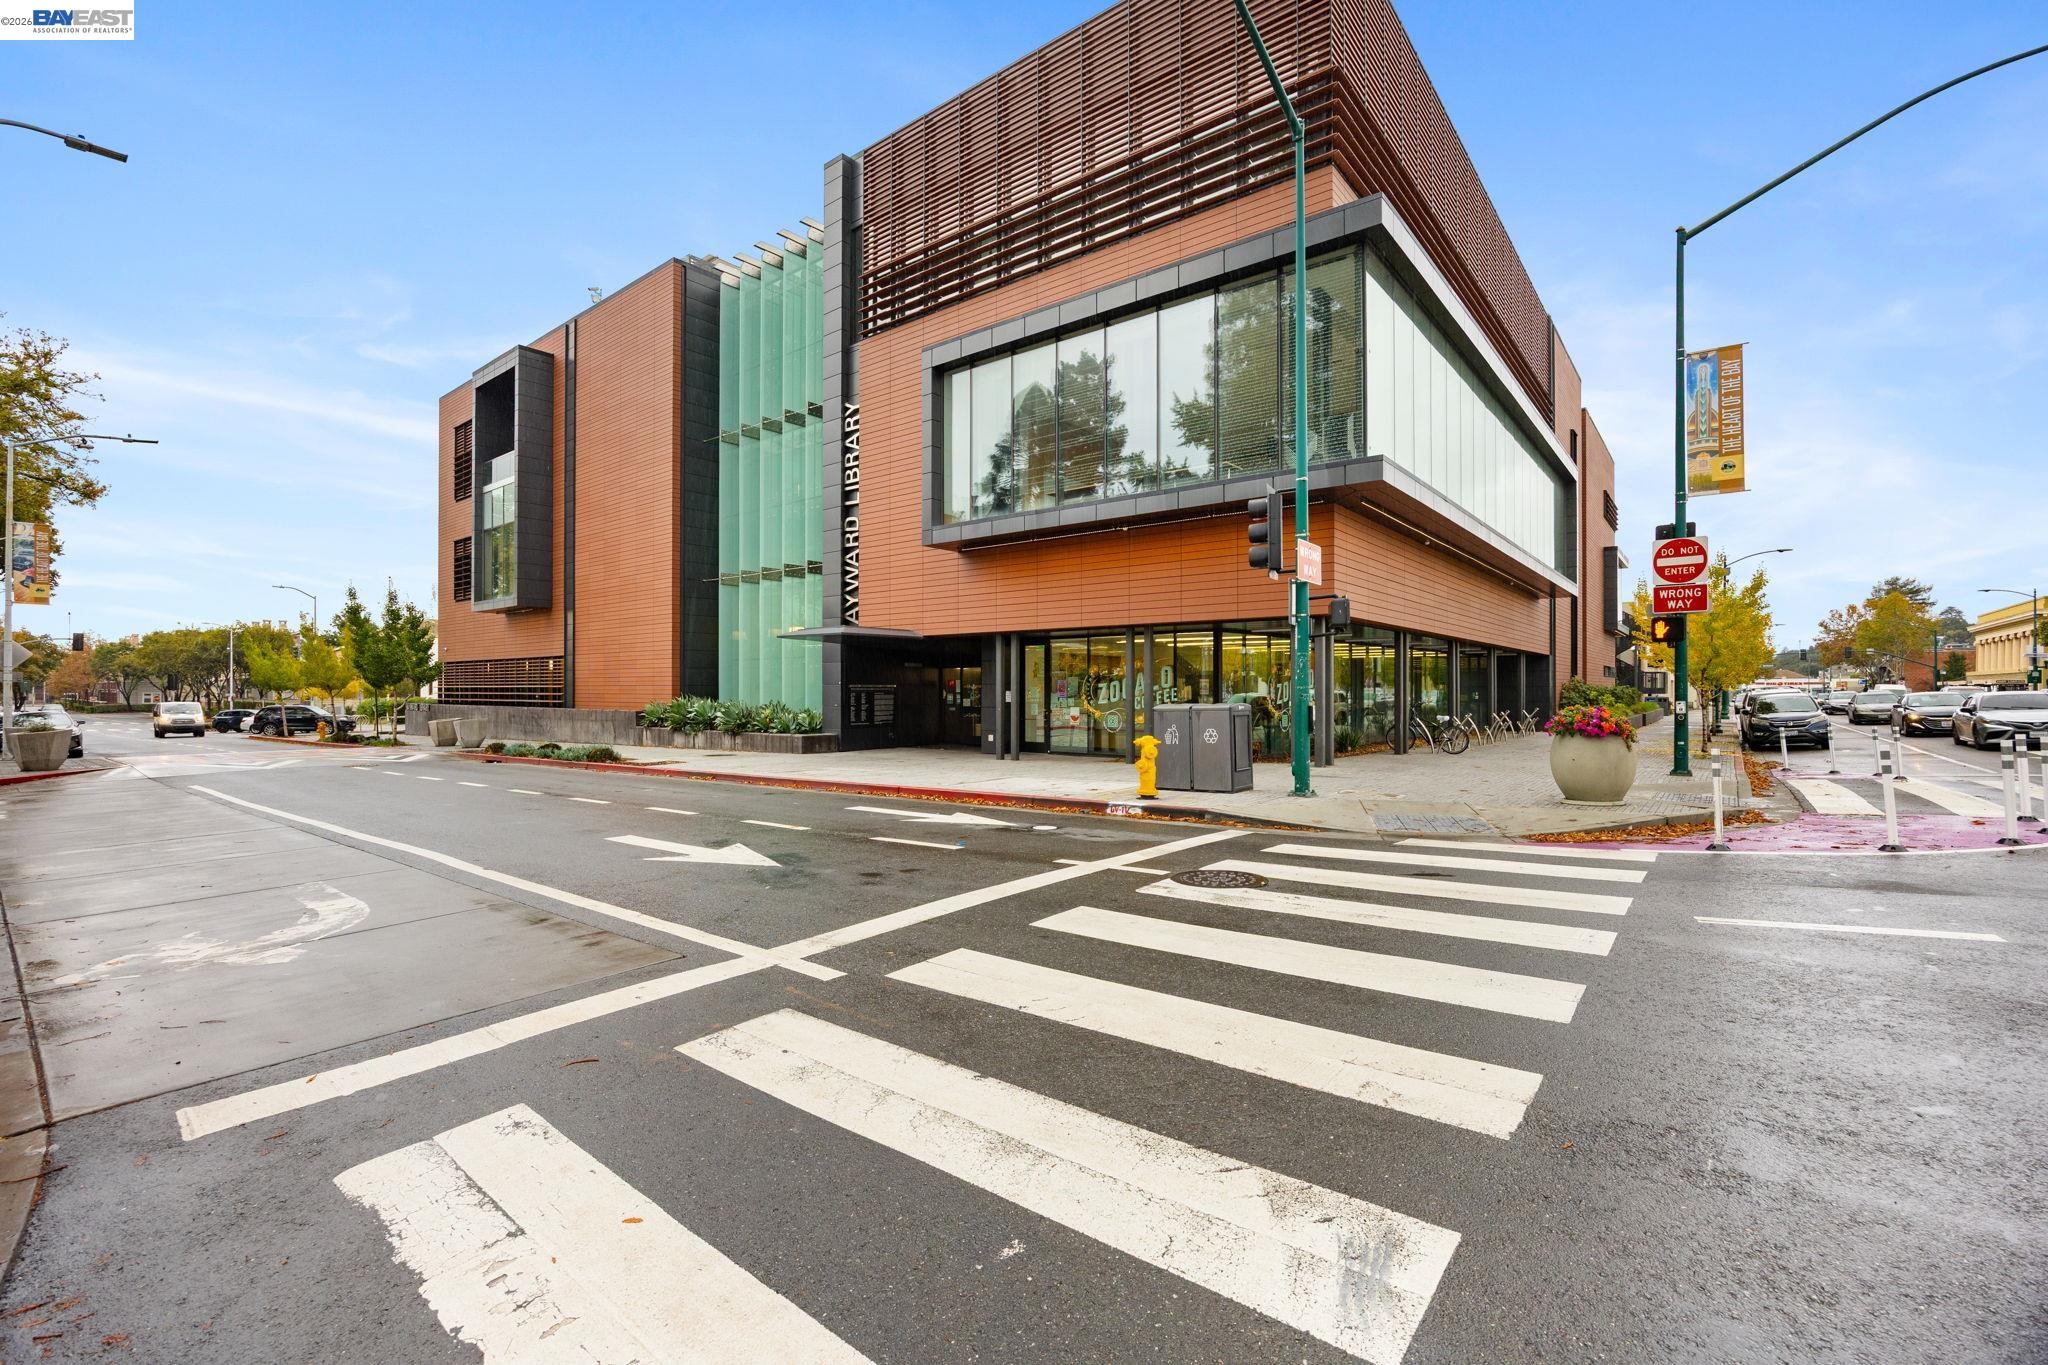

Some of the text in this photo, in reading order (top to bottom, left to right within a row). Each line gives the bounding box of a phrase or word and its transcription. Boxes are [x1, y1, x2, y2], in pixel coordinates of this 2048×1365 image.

[1721, 359, 1741, 453] THE HEART OF THE BAY
[844, 402, 860, 624] AYWARD LIBRARY
[1661, 546, 1699, 556] DO NOT
[1664, 567, 1696, 575] ENTER
[1659, 588, 1702, 599] WRONG
[1667, 599, 1693, 609] WAY
